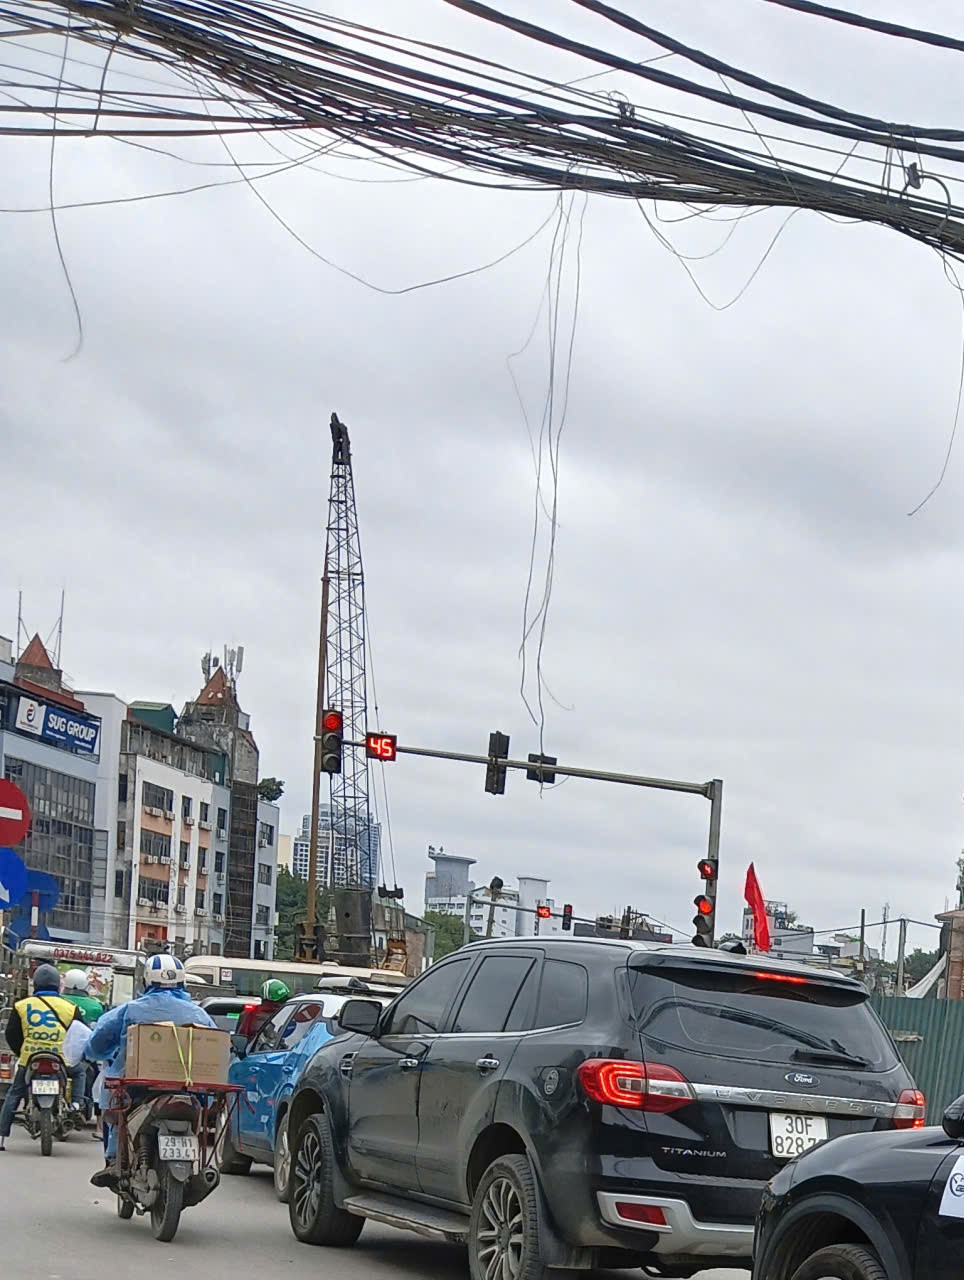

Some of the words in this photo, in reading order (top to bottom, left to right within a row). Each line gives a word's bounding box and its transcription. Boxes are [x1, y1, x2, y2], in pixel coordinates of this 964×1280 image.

[48, 713, 66, 732] SUG
[67, 721, 96, 741] GROUP
[370, 737, 392, 756] 45
[27, 1003, 58, 1028] be
[26, 1027, 60, 1042] Food
[794, 1073, 812, 1084] Ford
[714, 1089, 882, 1113] EVEREST
[785, 1115, 813, 1135] 30F
[164, 1137, 192, 1148] 29-H1
[661, 1146, 727, 1158] TITANIUM
